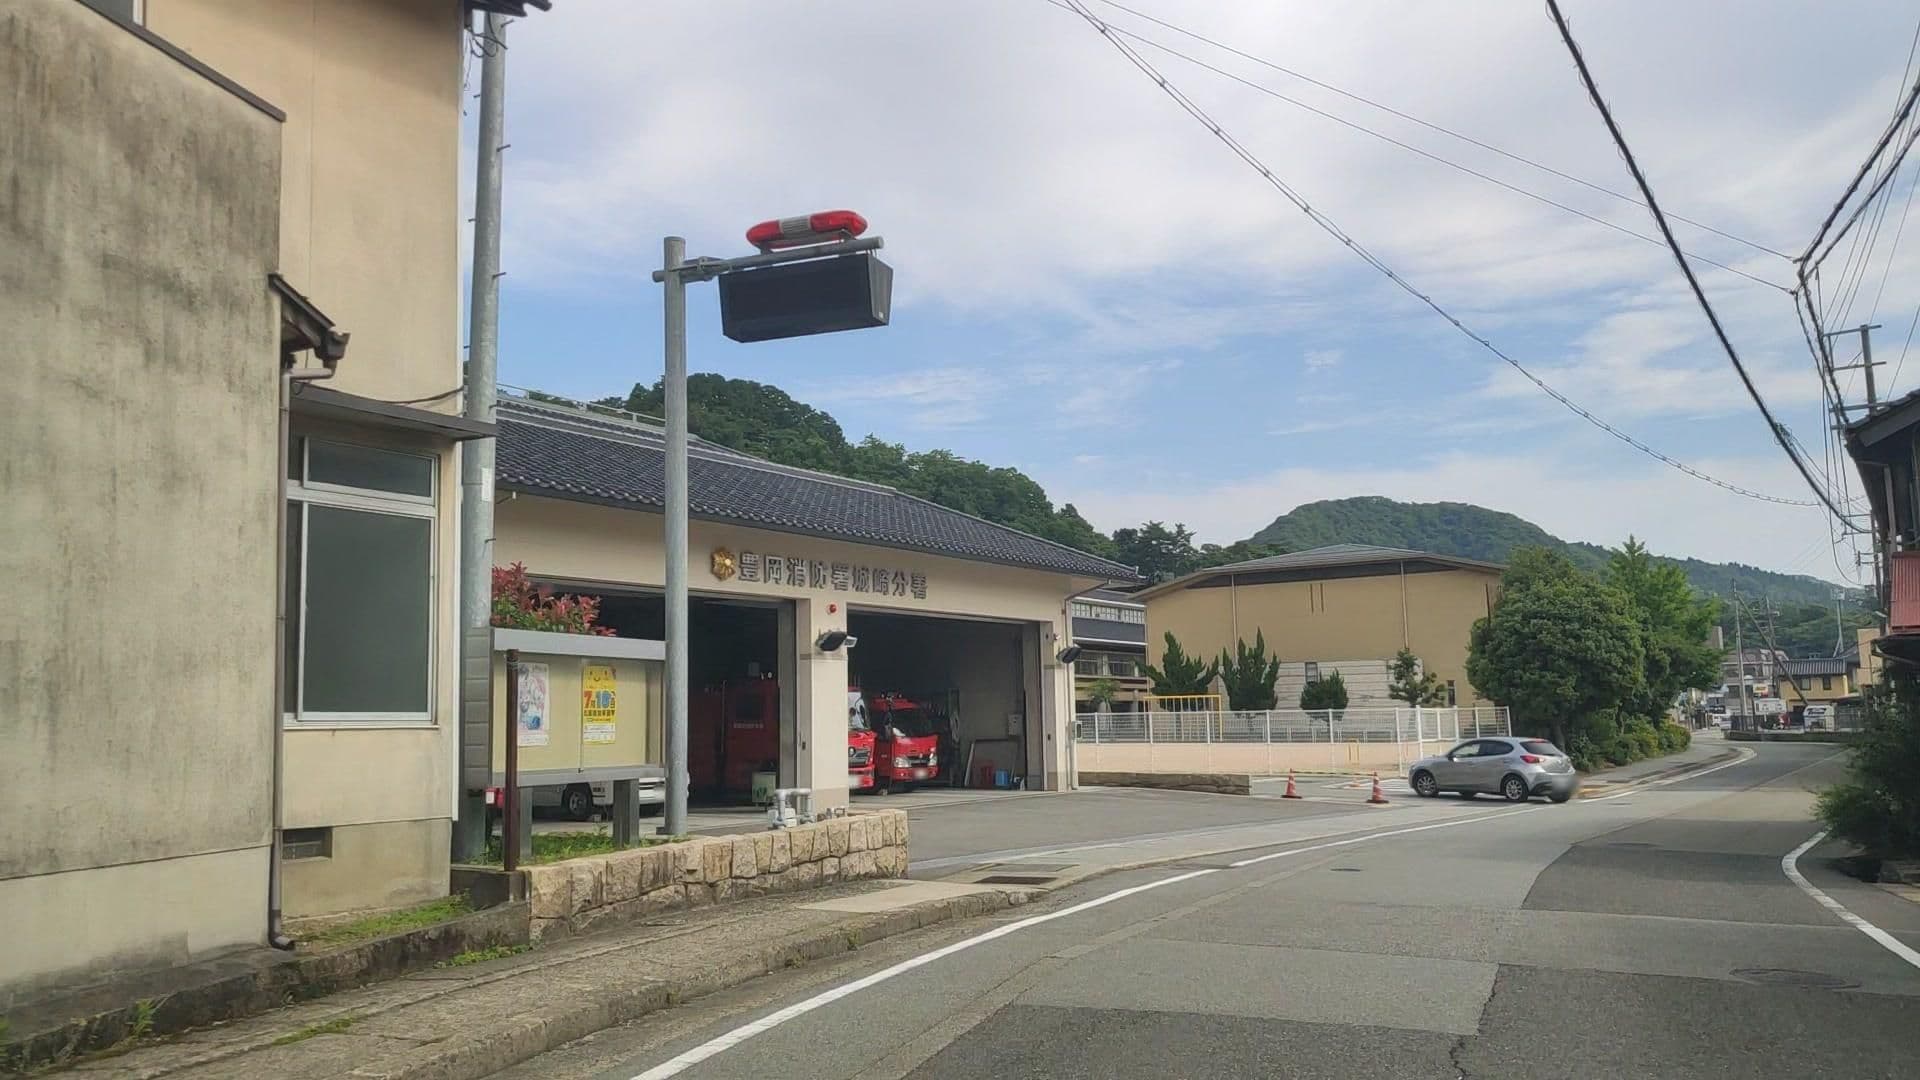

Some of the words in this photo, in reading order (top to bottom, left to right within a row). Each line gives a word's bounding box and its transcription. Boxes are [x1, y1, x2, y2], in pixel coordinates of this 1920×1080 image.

[738, 551, 928, 599] 豊岡消防署城崎分署
